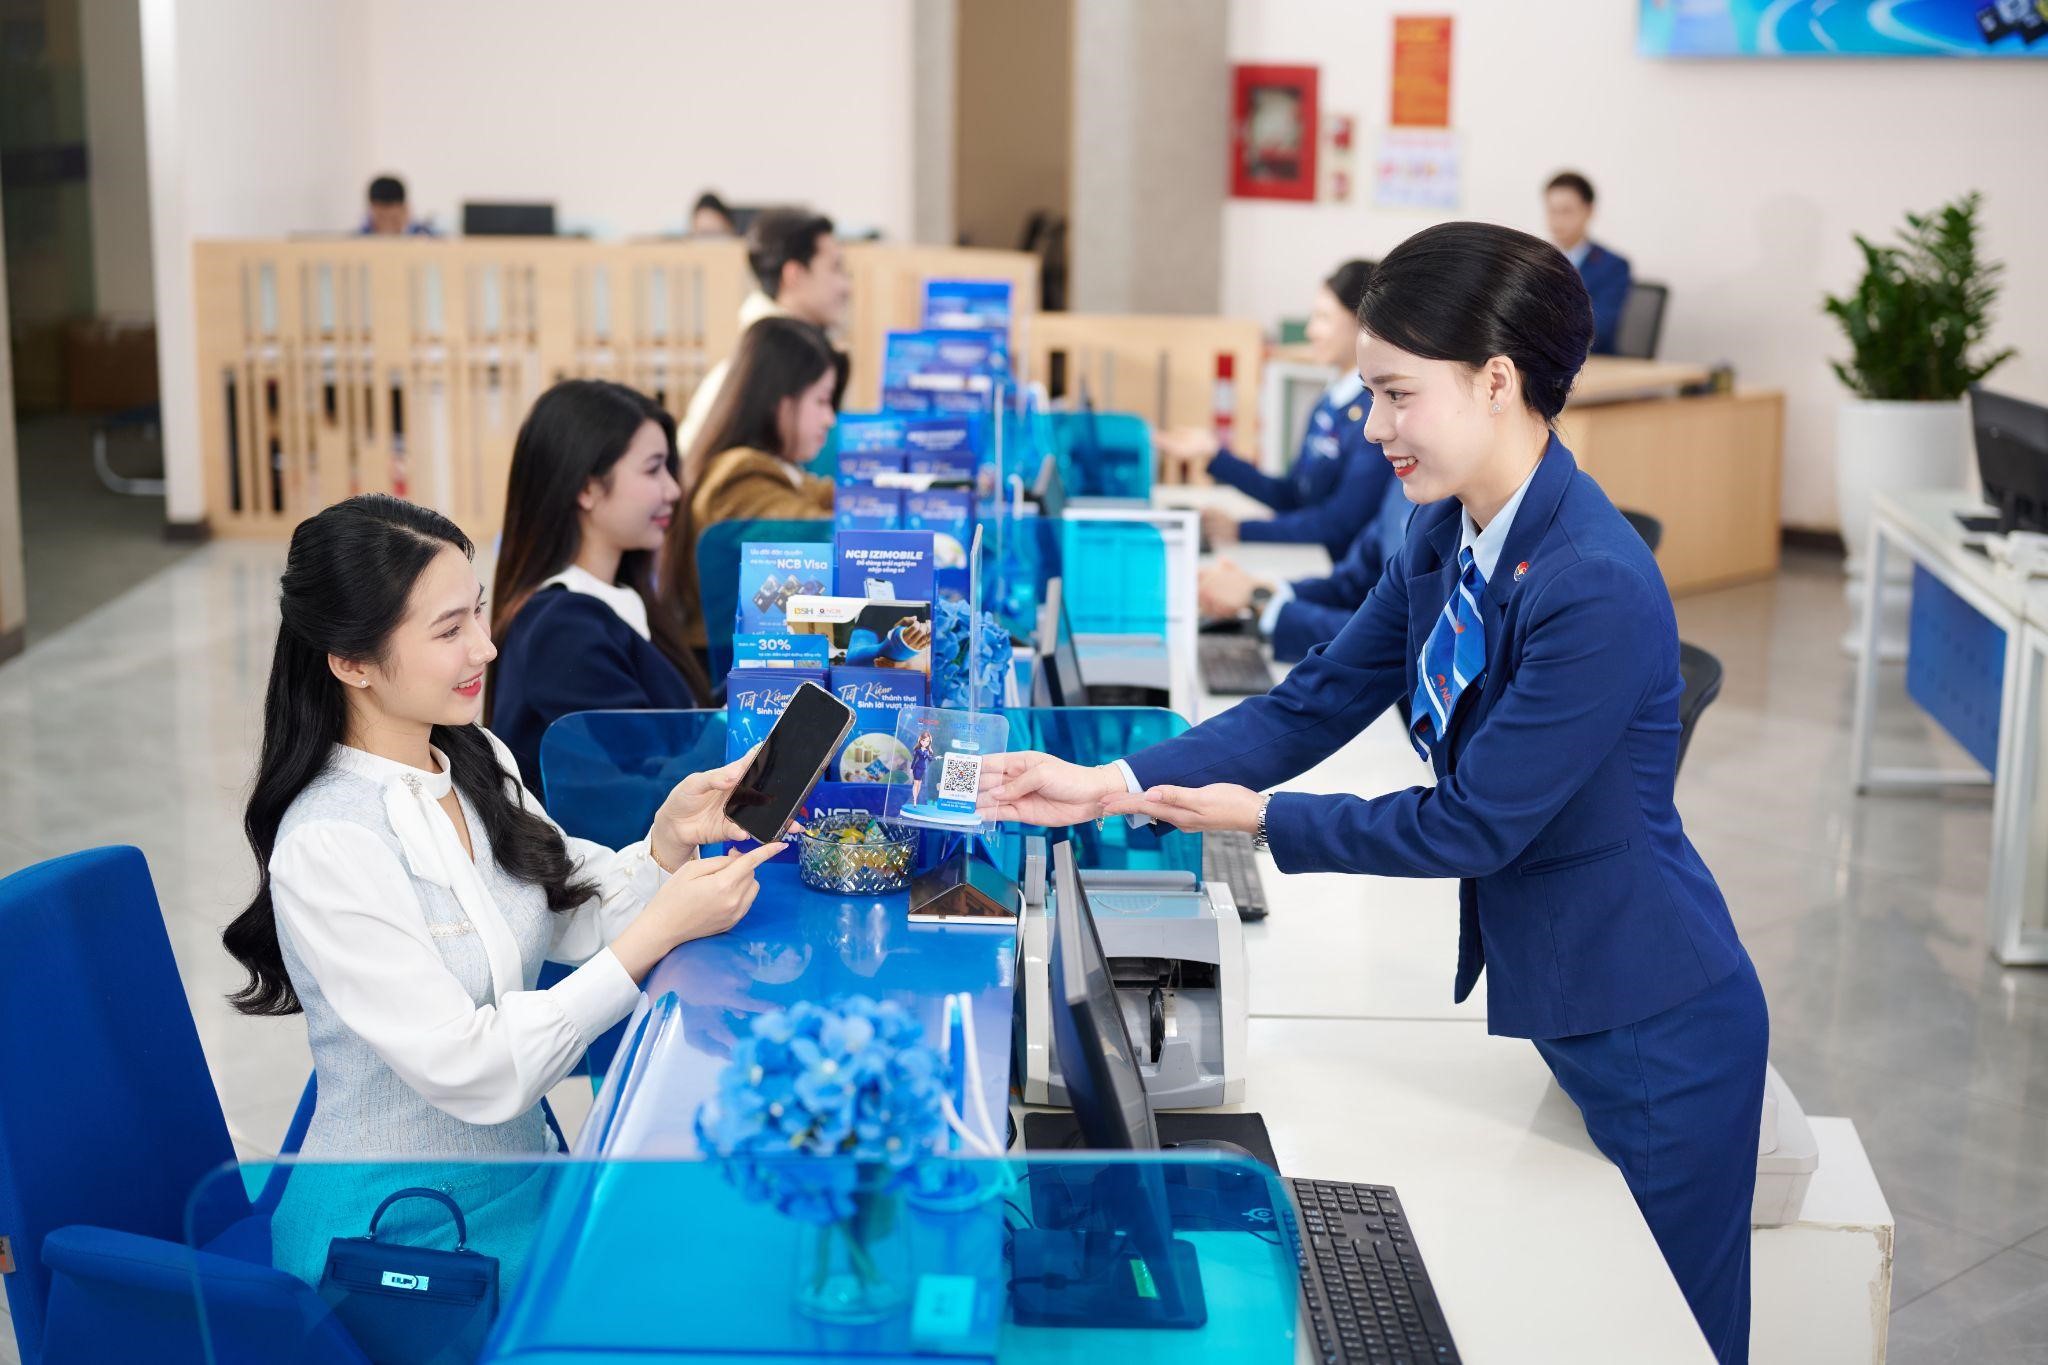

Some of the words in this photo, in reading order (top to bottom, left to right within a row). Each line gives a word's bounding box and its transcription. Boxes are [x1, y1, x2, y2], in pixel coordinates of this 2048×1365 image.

[845, 549, 868, 559] NCB
[868, 550, 924, 560] IZIMOBILE
[777, 558, 801, 569] NCB
[804, 559, 828, 569] Visa
[758, 638, 791, 650] 30%
